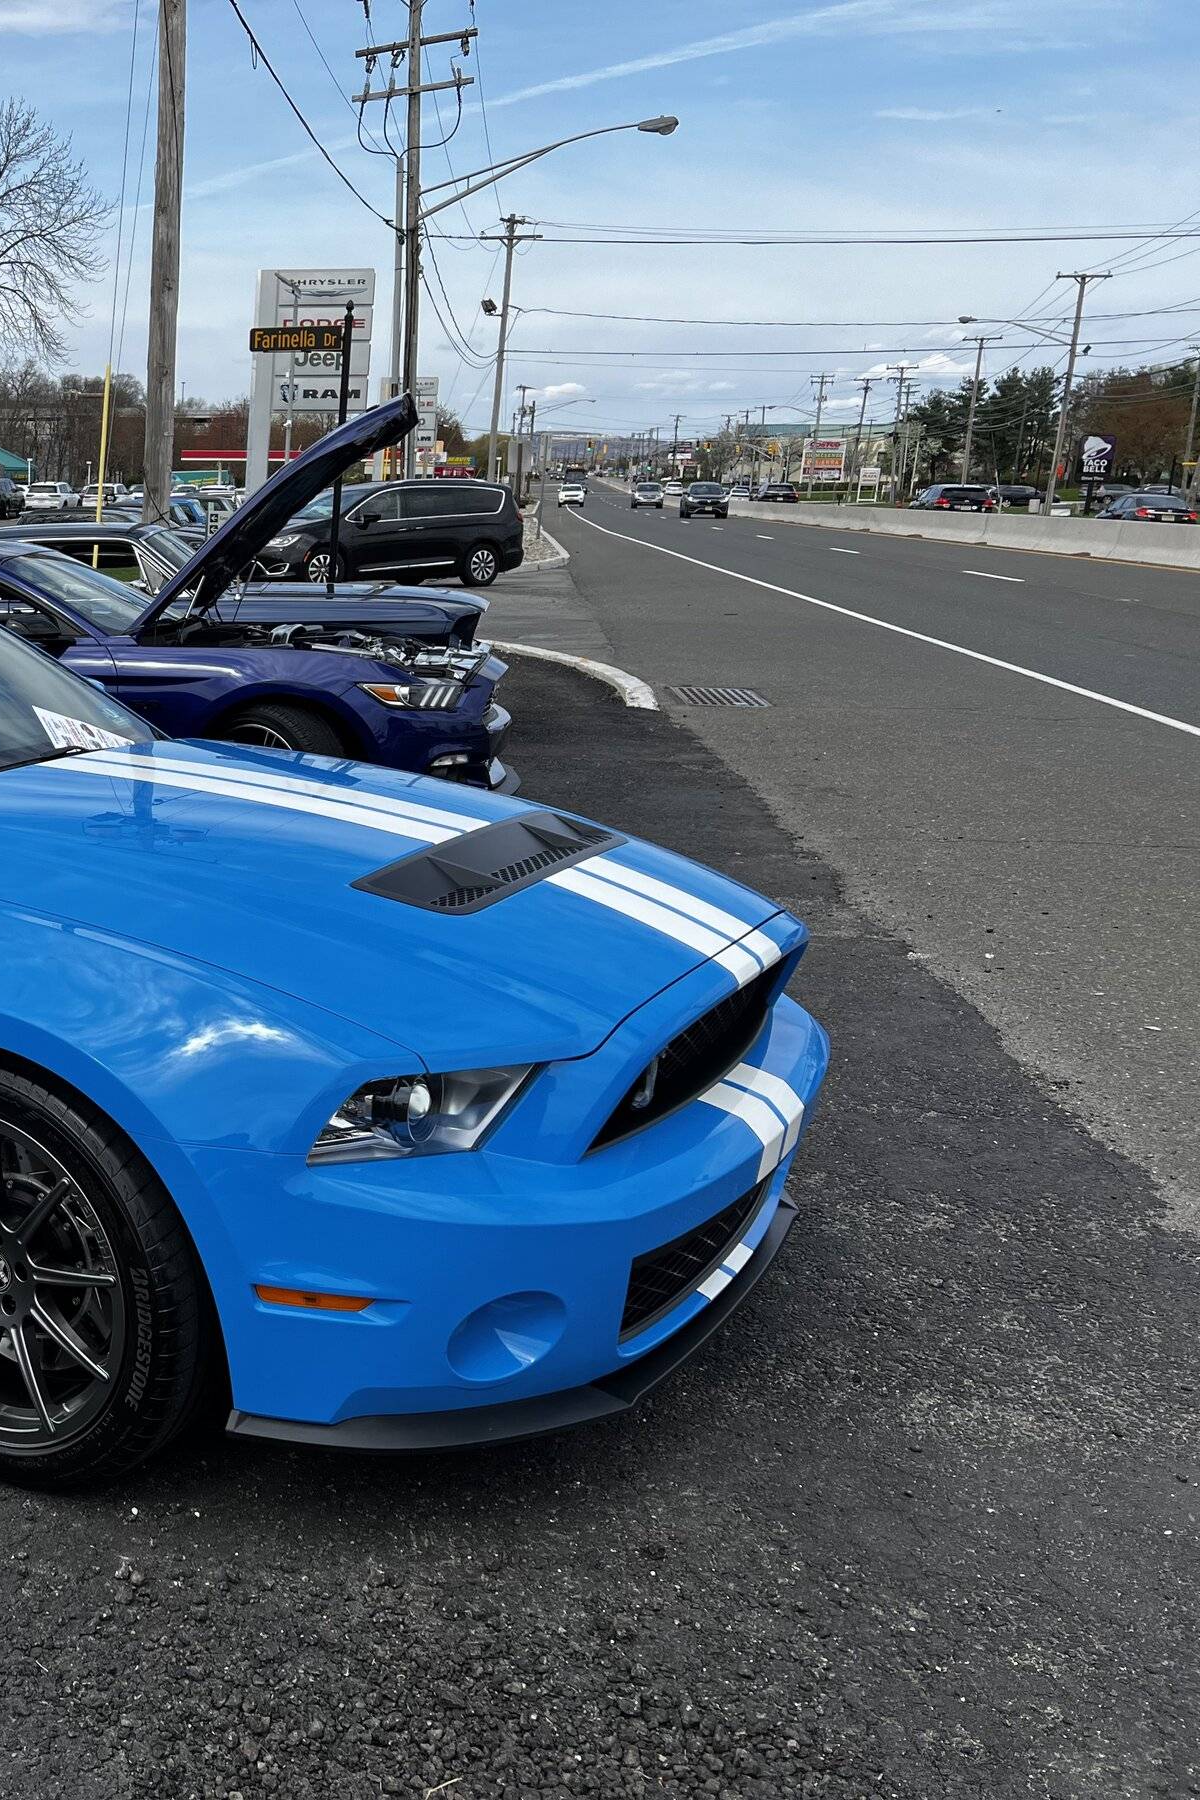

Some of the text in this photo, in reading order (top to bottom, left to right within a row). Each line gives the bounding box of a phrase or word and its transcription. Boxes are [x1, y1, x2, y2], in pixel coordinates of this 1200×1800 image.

[254, 329, 337, 349] Farinella Dr
[123, 1266, 153, 1414] BRIDGESTONE
